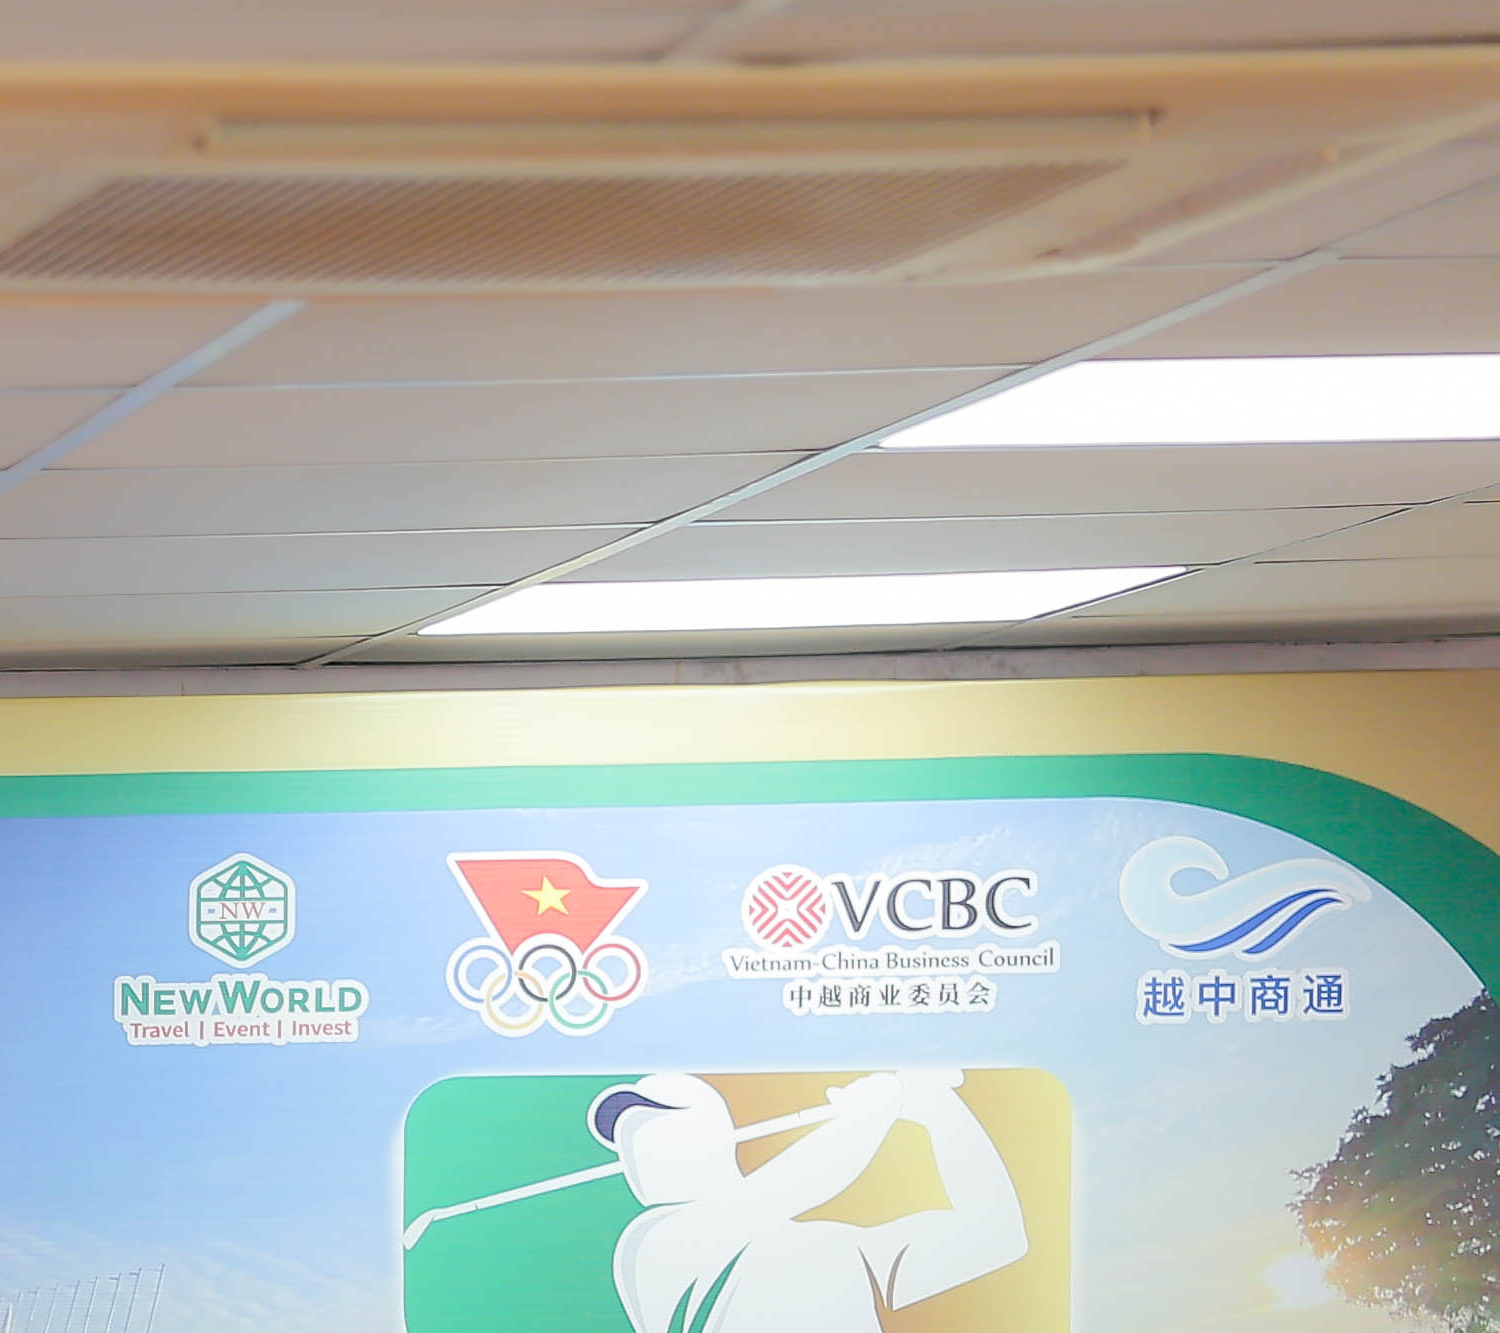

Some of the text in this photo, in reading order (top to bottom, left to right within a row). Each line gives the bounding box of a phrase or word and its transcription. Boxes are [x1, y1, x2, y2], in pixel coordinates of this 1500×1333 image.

[219, 901, 265, 920] NW
[831, 877, 1033, 933] VCBC
[729, 947, 1055, 973] Vietnam-China Business Council
[789, 981, 990, 1009] 中越商业委员会
[1143, 974, 1345, 1018] 越中商通
[131, 1018, 353, 1038] Travel Event Invest
